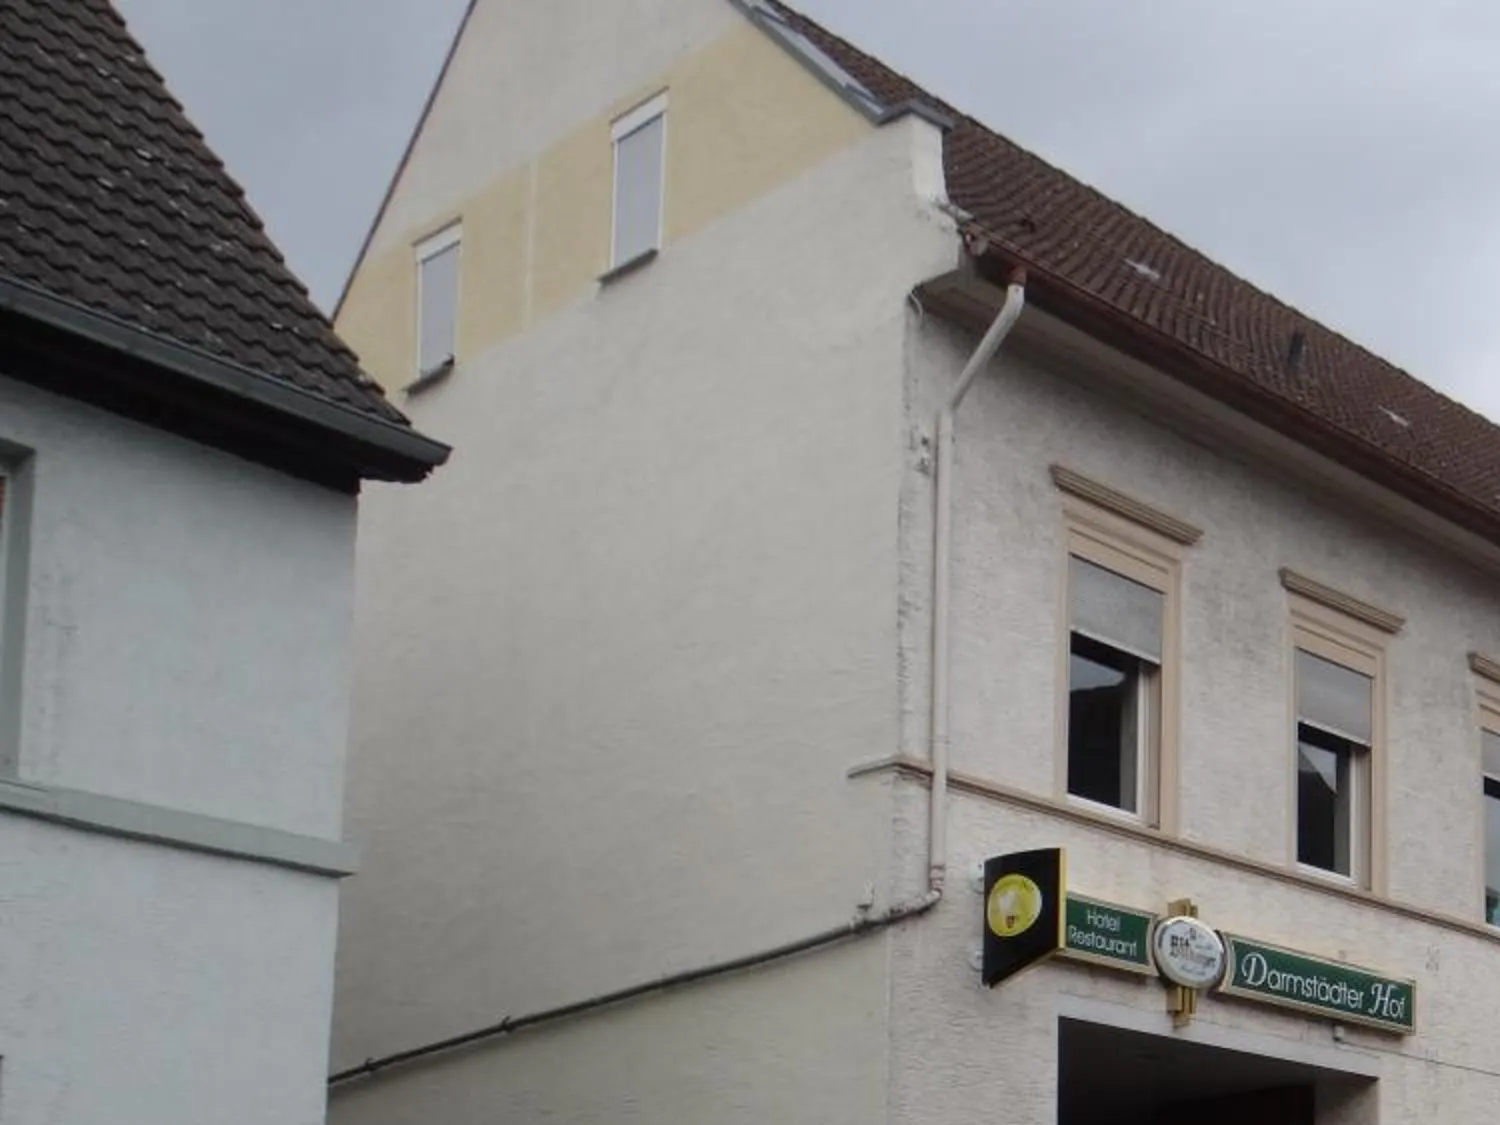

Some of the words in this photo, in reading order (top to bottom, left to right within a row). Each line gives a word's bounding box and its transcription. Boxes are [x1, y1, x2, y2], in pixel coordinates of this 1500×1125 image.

[1087, 908, 1120, 932] Hotel
[1068, 924, 1137, 957] Restaurant
[1241, 951, 1364, 1009] Darmstädter
[1368, 982, 1407, 1018] Hof
